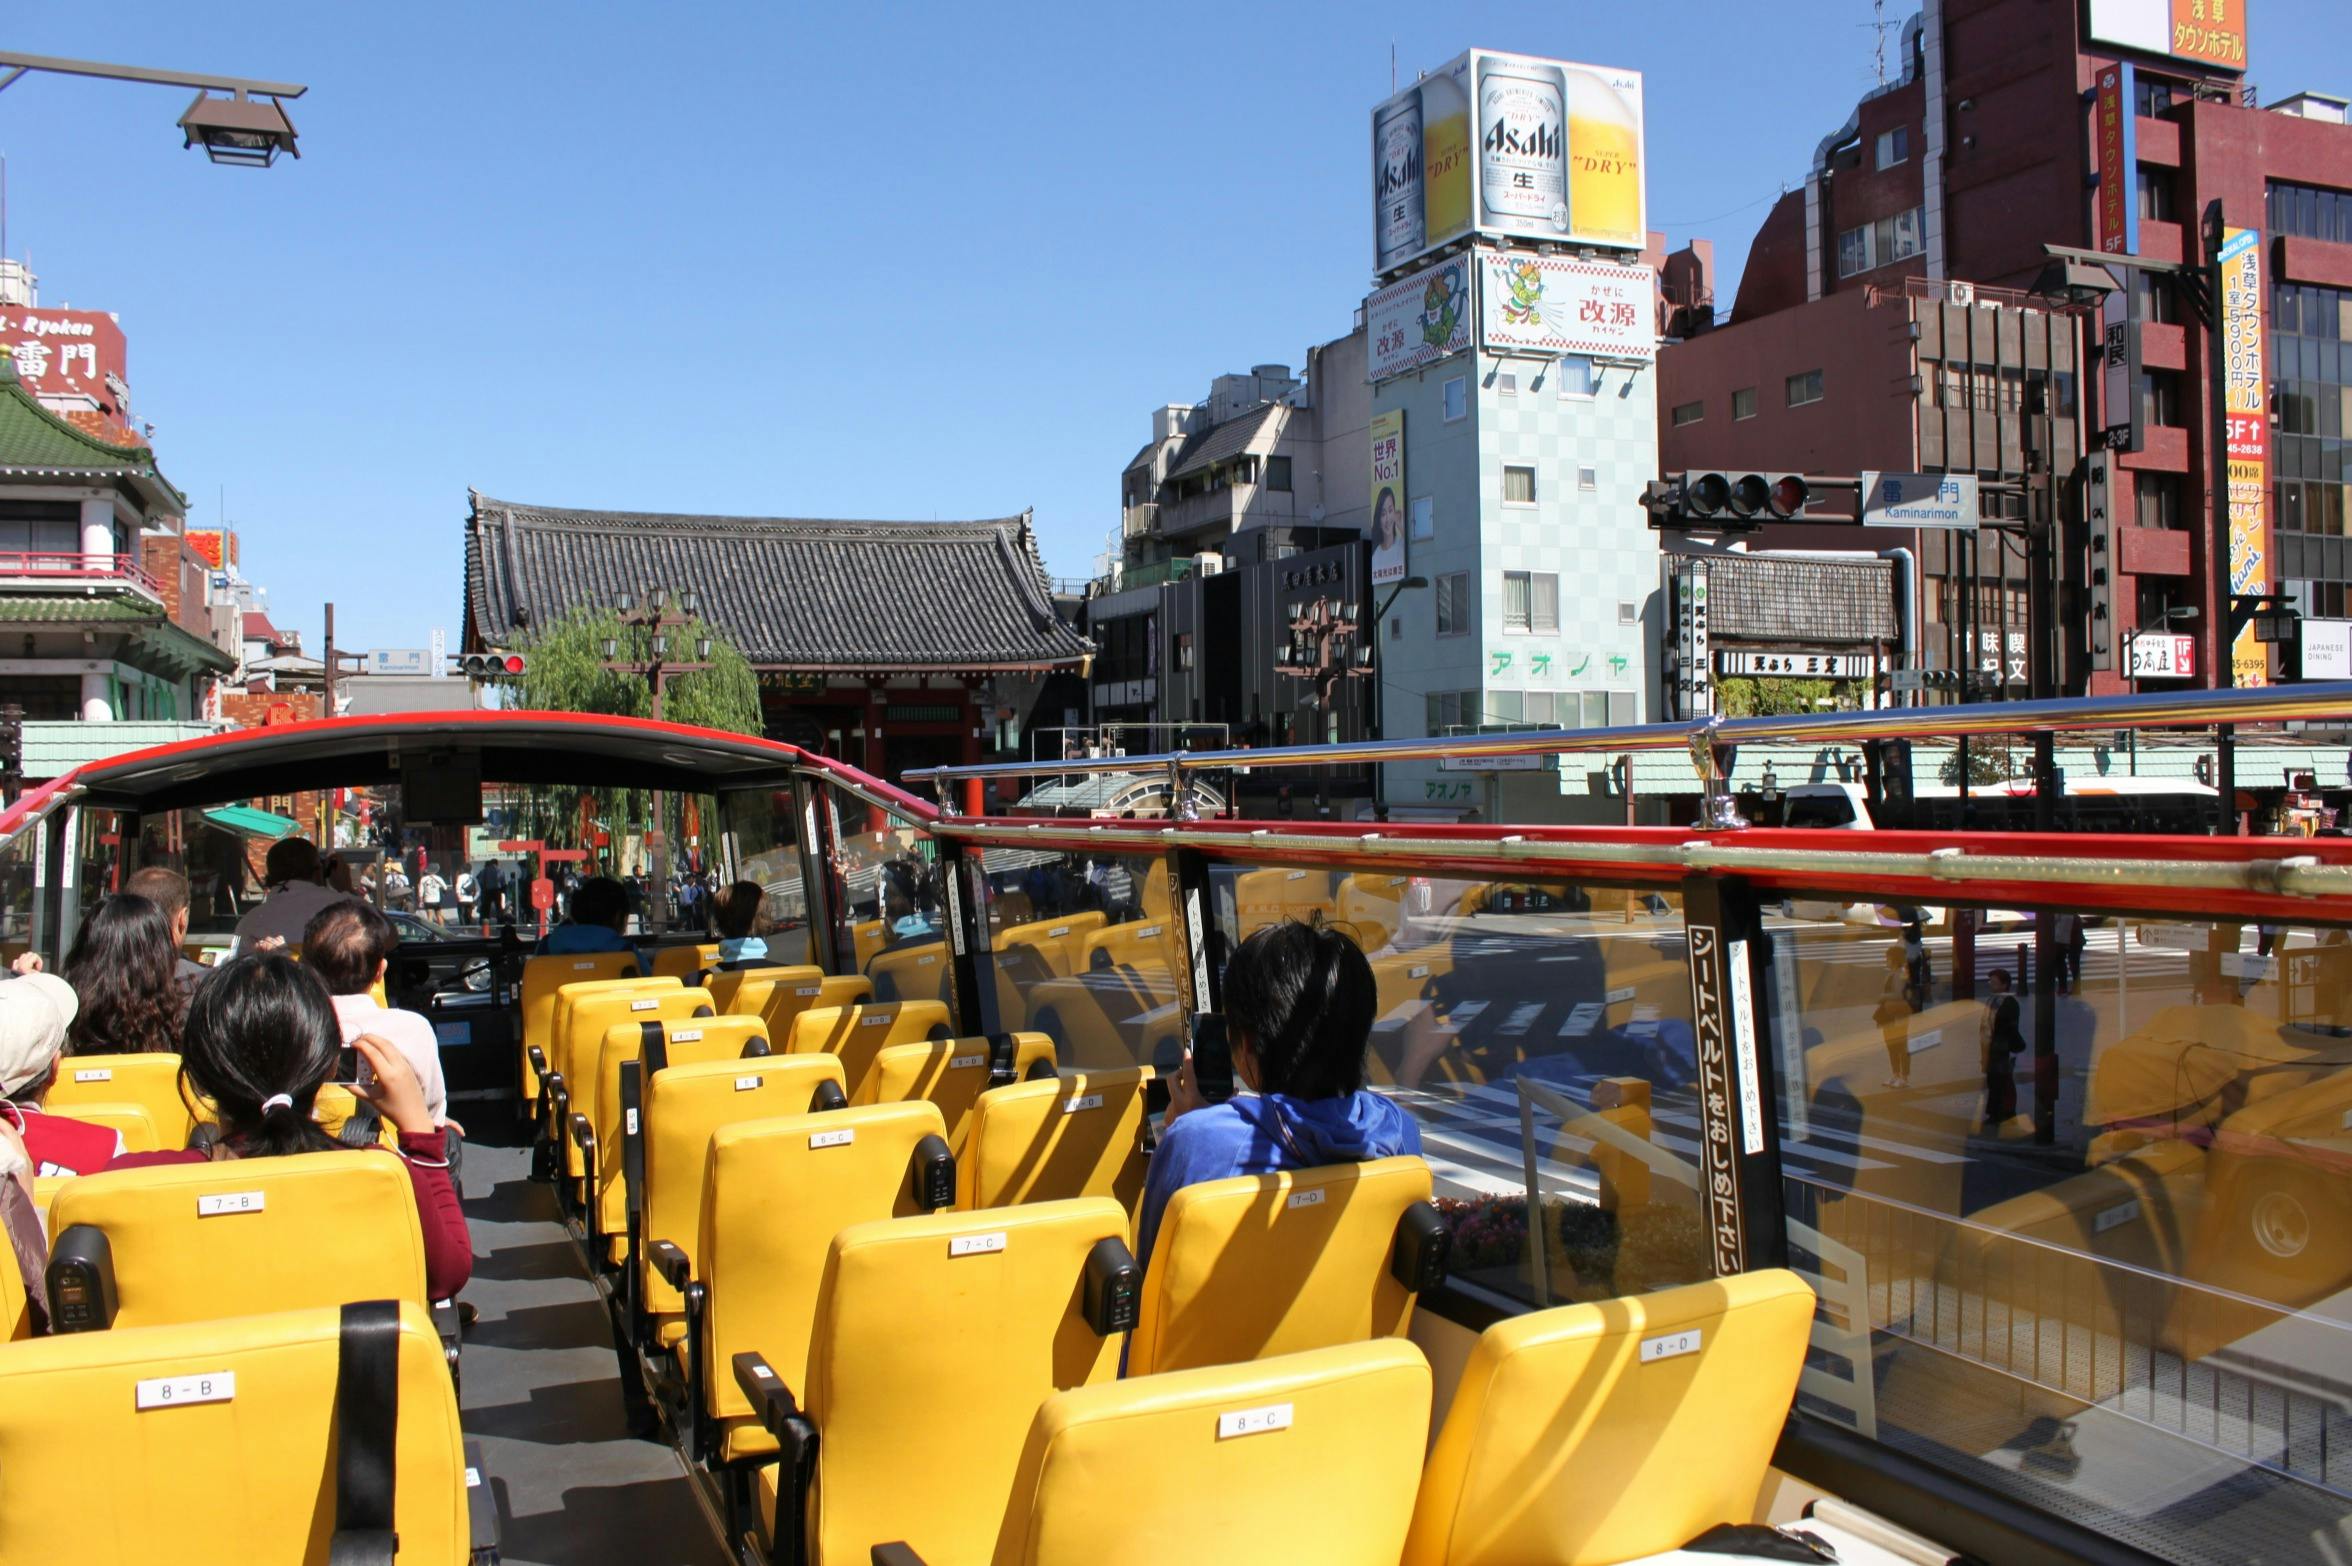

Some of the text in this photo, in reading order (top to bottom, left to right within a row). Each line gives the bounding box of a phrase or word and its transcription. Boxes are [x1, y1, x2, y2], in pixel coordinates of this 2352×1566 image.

[2174, 20, 2243, 61] タウンホテル
[1613, 79, 1635, 90] Asahi
[1485, 116, 1560, 160] Asahi
[1378, 151, 1420, 197] Asahi
[2103, 95, 2120, 232] 浅草タウンホテル
[1513, 172, 1535, 189] 生
[1393, 205, 1405, 222] 生
[2105, 234, 2122, 252] 5F
[1591, 284, 1623, 297] かぜに
[1578, 299, 1636, 327] 改源
[22, 316, 94, 337] Ryokan
[1592, 326, 1625, 336] カイゲン
[2242, 253, 2261, 410] 浅草タウンホテル
[1377, 328, 1405, 356] 改源
[12, 340, 97, 380] 雷門
[2226, 419, 2247, 440] 5F
[1374, 438, 1397, 463] 世界
[1374, 459, 1399, 482] No.1
[1883, 481, 1959, 503] 雷門
[1885, 506, 1959, 520] Kaminarimon
[2230, 545, 2261, 596] iami
[2176, 640, 2192, 657] 1F
[2308, 644, 2344, 652] JAPANESE
[2308, 652, 2332, 661] DINING
[1491, 652, 1628, 678] アオノヤ
[1806, 656, 1838, 675] 三定
[1694, 658, 1707, 694] 三定
[1426, 782, 1472, 800] アオノヤ
[1692, 930, 1741, 1273] シートベルトをおしめ下さい
[215, 1195, 250, 1211] 7-B
[964, 1237, 993, 1250] 7-C
[1656, 1337, 1688, 1356] 8-D
[161, 1380, 212, 1401] 8-B
[1237, 1411, 1276, 1430] 8-C
